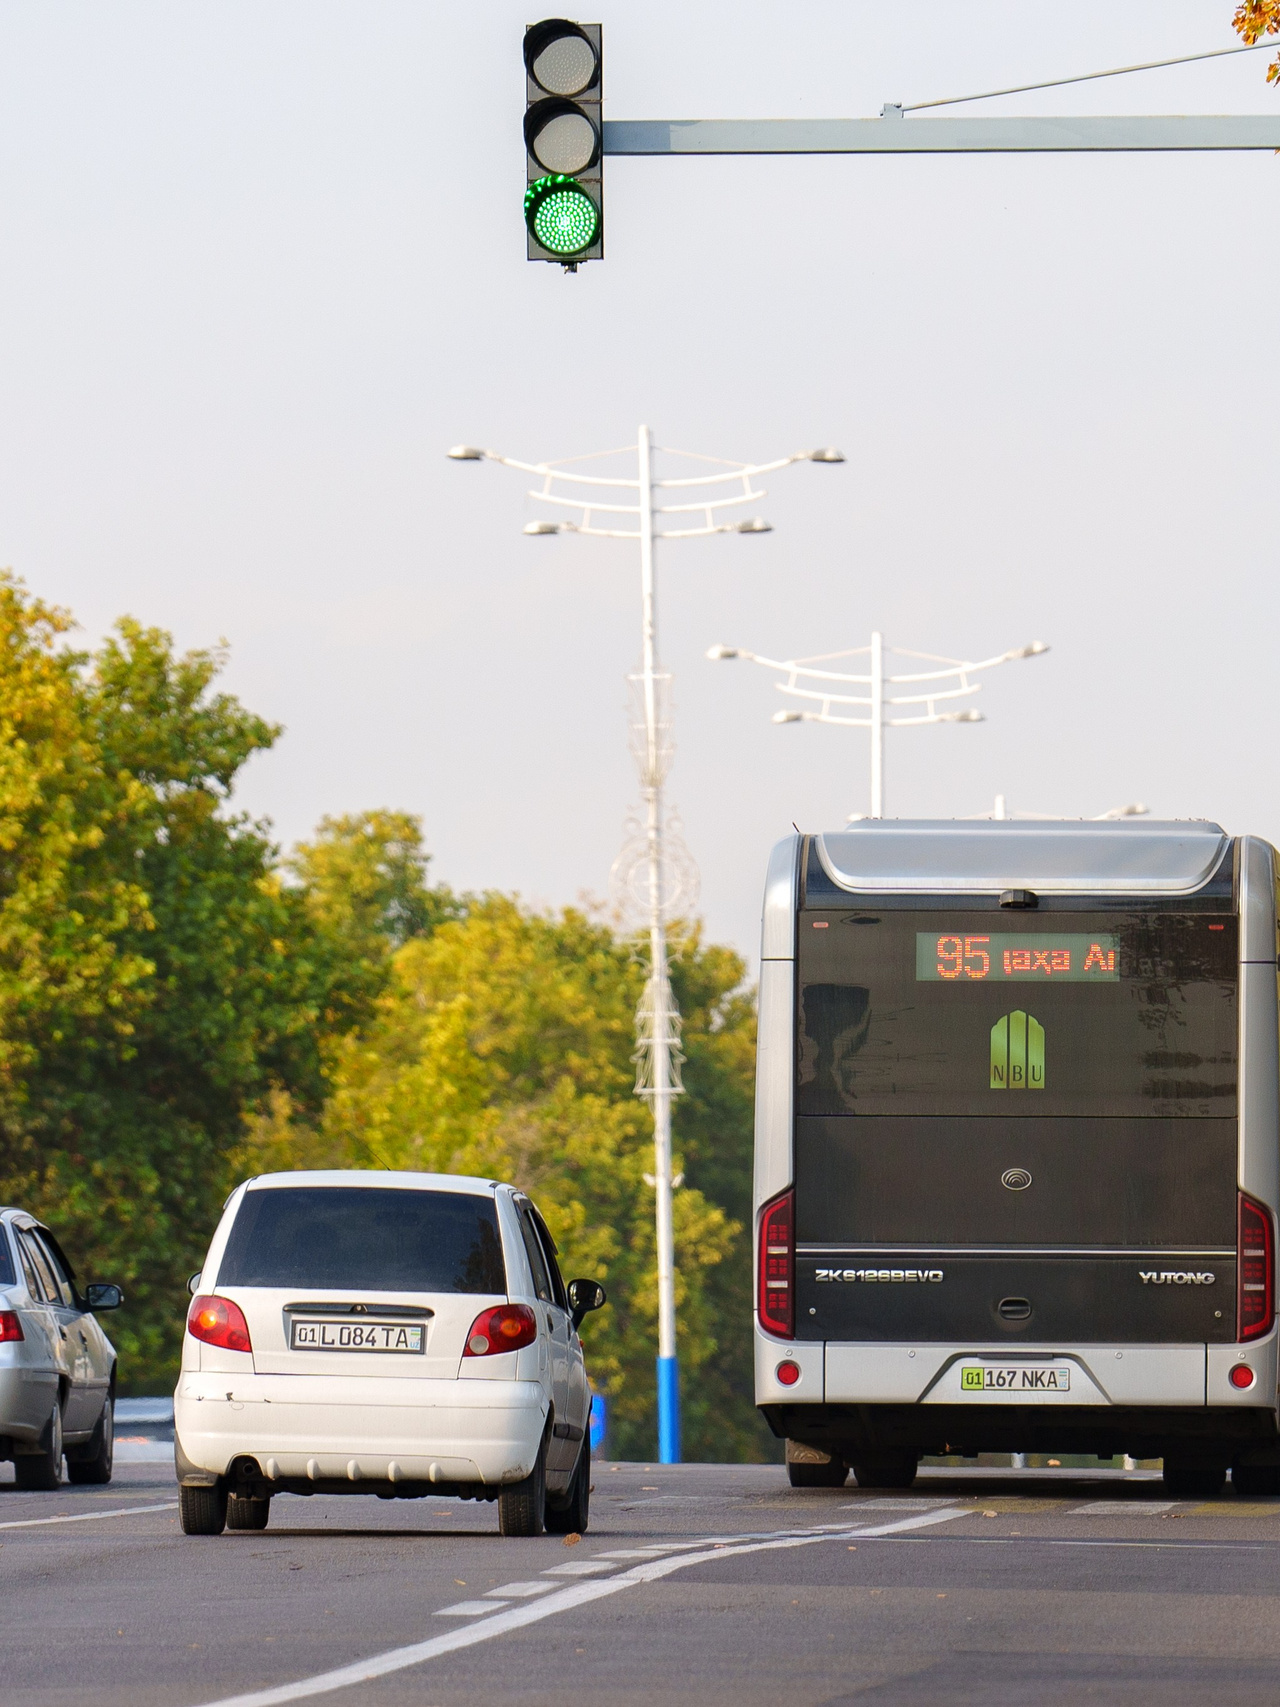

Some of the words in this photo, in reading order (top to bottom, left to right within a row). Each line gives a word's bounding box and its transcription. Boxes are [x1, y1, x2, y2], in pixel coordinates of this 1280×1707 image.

[937, 936, 990, 979] 95
[993, 1064, 1042, 1082] NBU
[1138, 1271, 1216, 1285] YUTONG
[298, 1327, 317, 1343] 01
[966, 1371, 982, 1385] 01
[985, 1370, 1017, 1388] 167
[1022, 1370, 1058, 1388] NKA
